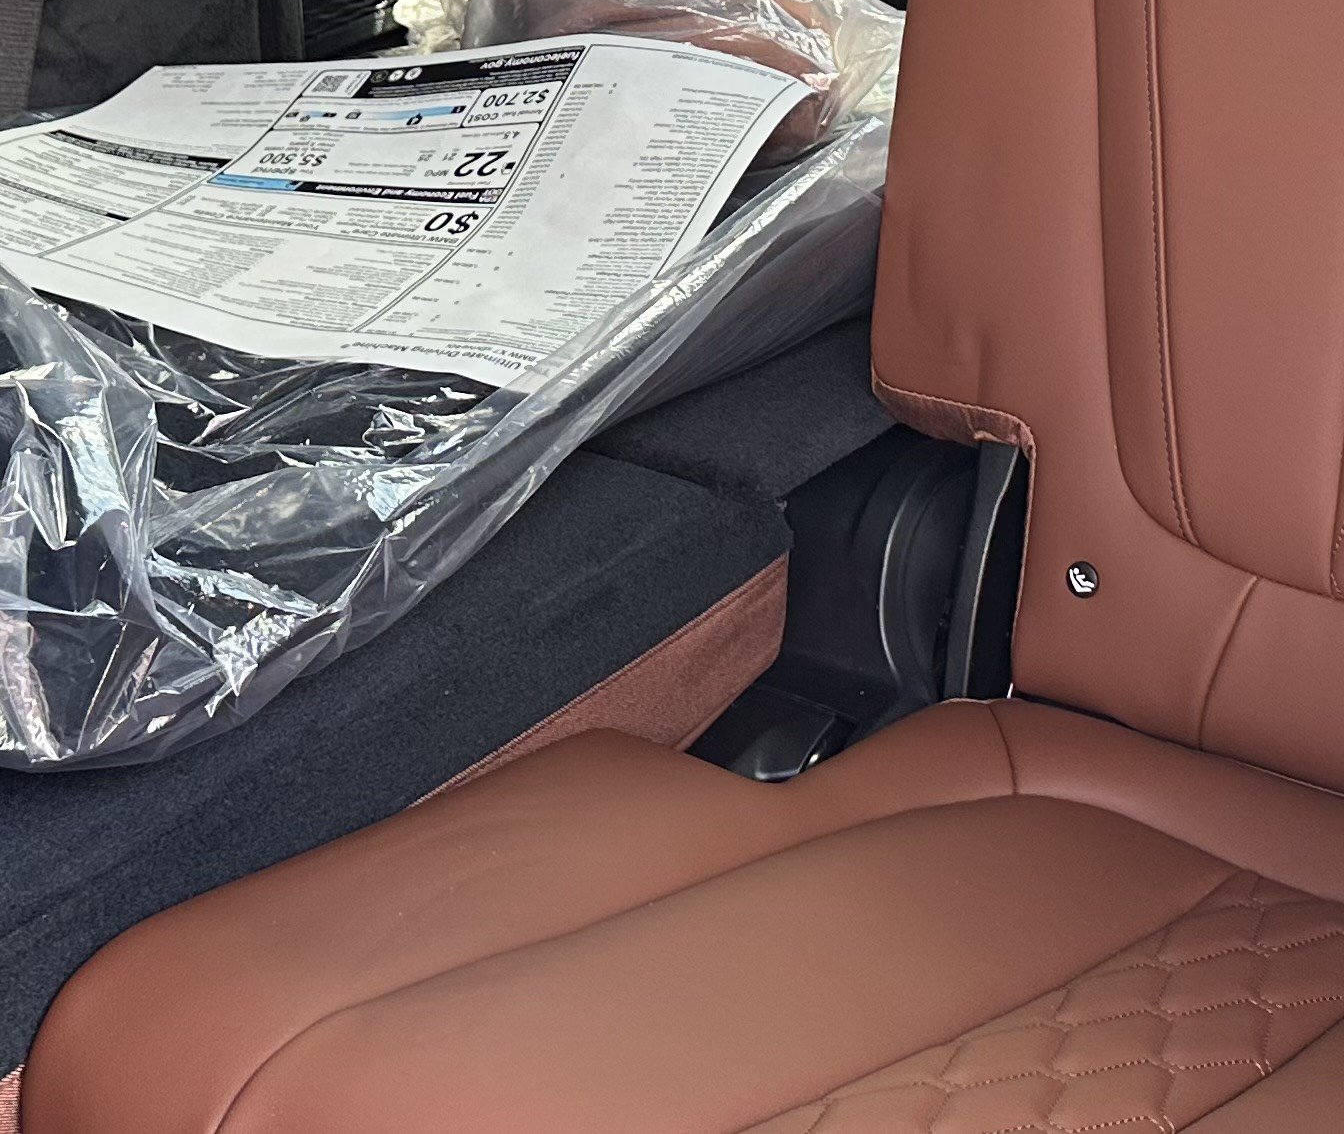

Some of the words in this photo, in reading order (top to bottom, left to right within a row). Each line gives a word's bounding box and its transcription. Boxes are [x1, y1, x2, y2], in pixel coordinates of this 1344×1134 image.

[479, 49, 580, 70] fueleconomy.gov
[483, 88, 550, 108] $2,700
[467, 112, 500, 124] cost
[502, 130, 521, 140] 4.5
[259, 153, 327, 167] $5,500
[442, 153, 457, 162] 21
[454, 151, 508, 177] 22
[250, 167, 298, 176] spend
[316, 183, 382, 195] Environment
[381, 187, 405, 196] and
[405, 188, 455, 200] Economy
[455, 191, 479, 200] Fuel
[423, 210, 479, 236] $0
[381, 229, 427, 241] Ultimate
[427, 234, 459, 244] BMW
[410, 344, 462, 359] Driving
[509, 352, 537, 362] BMW
[462, 350, 523, 370] Ultimate
